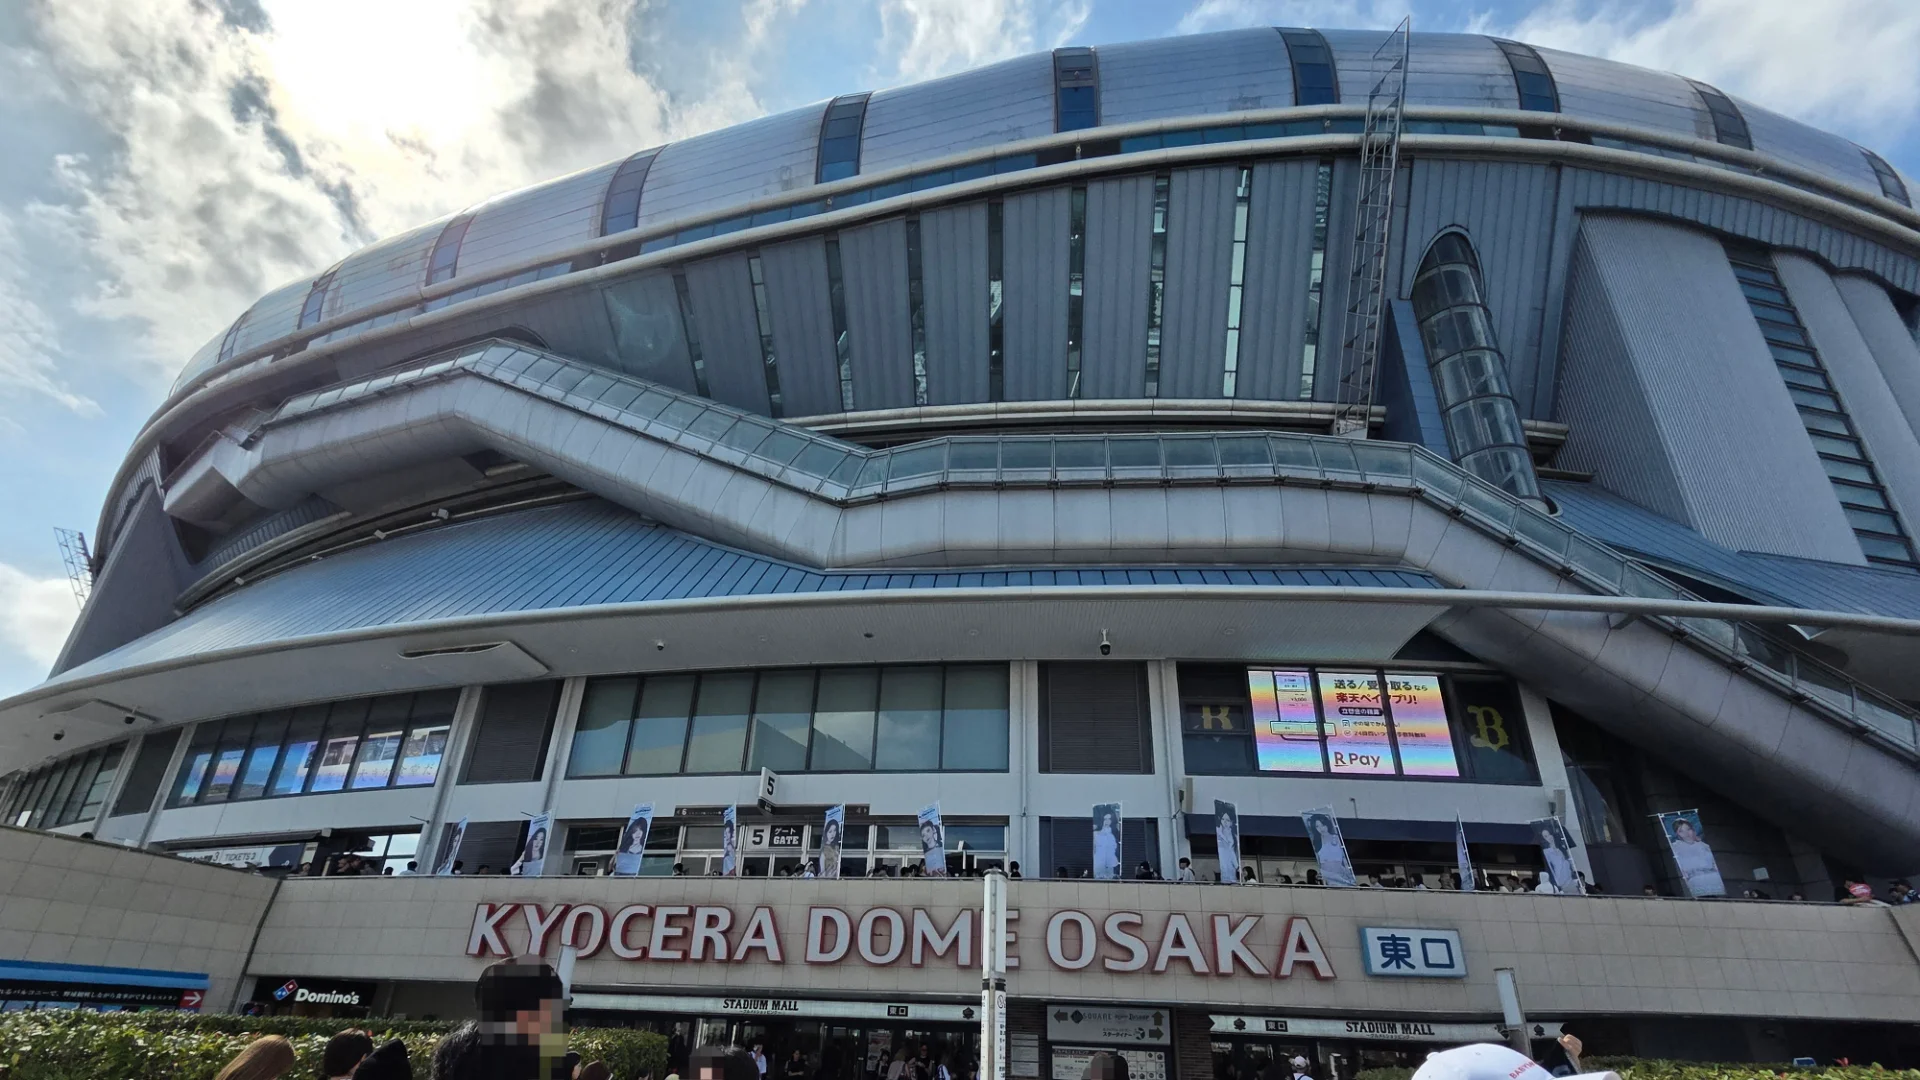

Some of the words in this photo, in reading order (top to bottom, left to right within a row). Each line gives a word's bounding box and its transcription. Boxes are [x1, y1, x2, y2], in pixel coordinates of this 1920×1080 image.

[1336, 692, 1418, 704] 楽天ペイプリ!
[1333, 751, 1348, 767] R
[1349, 752, 1380, 768] Pay
[766, 776, 775, 796] 5
[681, 808, 688, 816] 6
[752, 828, 765, 846] 5
[774, 827, 796, 835] ゲート
[773, 835, 799, 845] GATE
[225, 853, 250, 861] TICKETS
[466, 902, 785, 964] KYOCERA
[1046, 909, 1337, 980] OSAKA
[1376, 934, 1455, 970] 東口
[295, 988, 360, 1005] Domino's
[723, 998, 768, 1010] STADIUM
[771, 1000, 799, 1011] MALL
[889, 1007, 907, 1015] 東口
[1266, 1021, 1286, 1031] 東口
[1345, 1021, 1398, 1034] STADIUM
[1401, 1023, 1435, 1036] MALL
